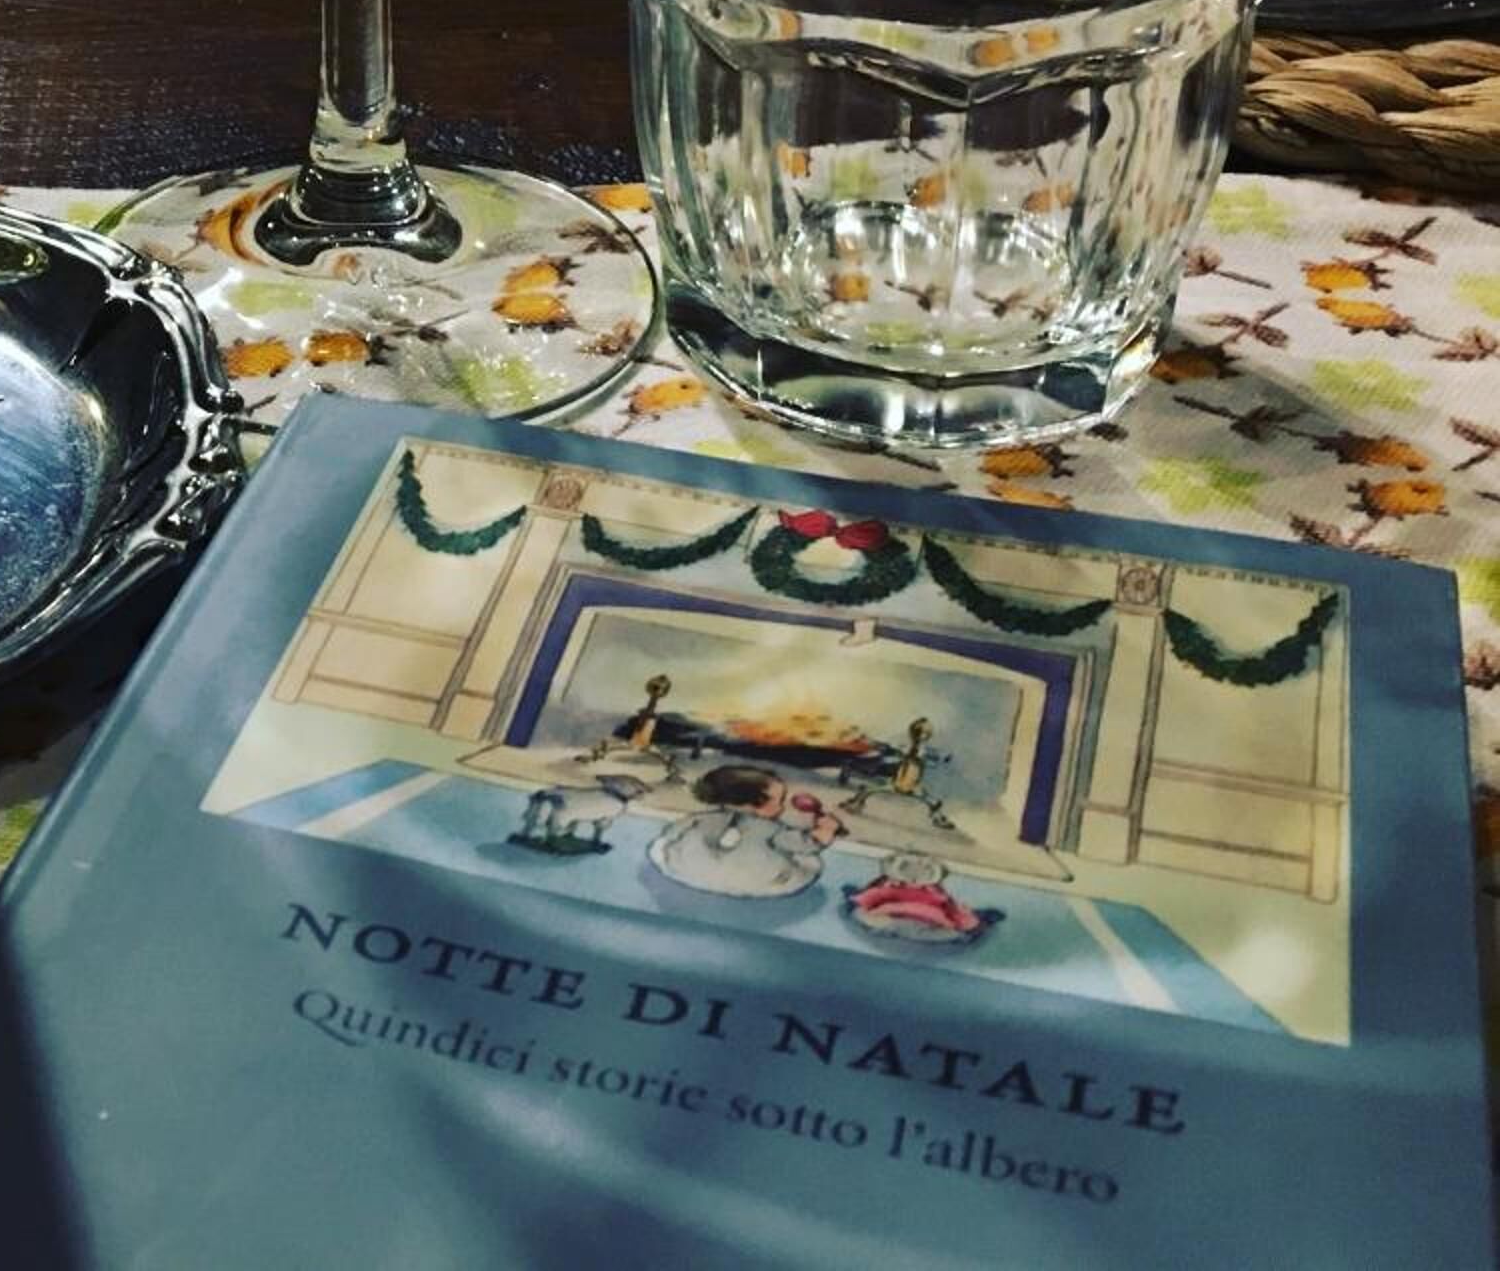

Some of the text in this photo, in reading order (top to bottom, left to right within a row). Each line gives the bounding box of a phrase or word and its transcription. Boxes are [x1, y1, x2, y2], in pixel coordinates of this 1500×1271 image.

[282, 902, 1187, 1136] NOTTE DI NATALE
[292, 988, 1121, 1205] Quindici storie sotto l'albero
